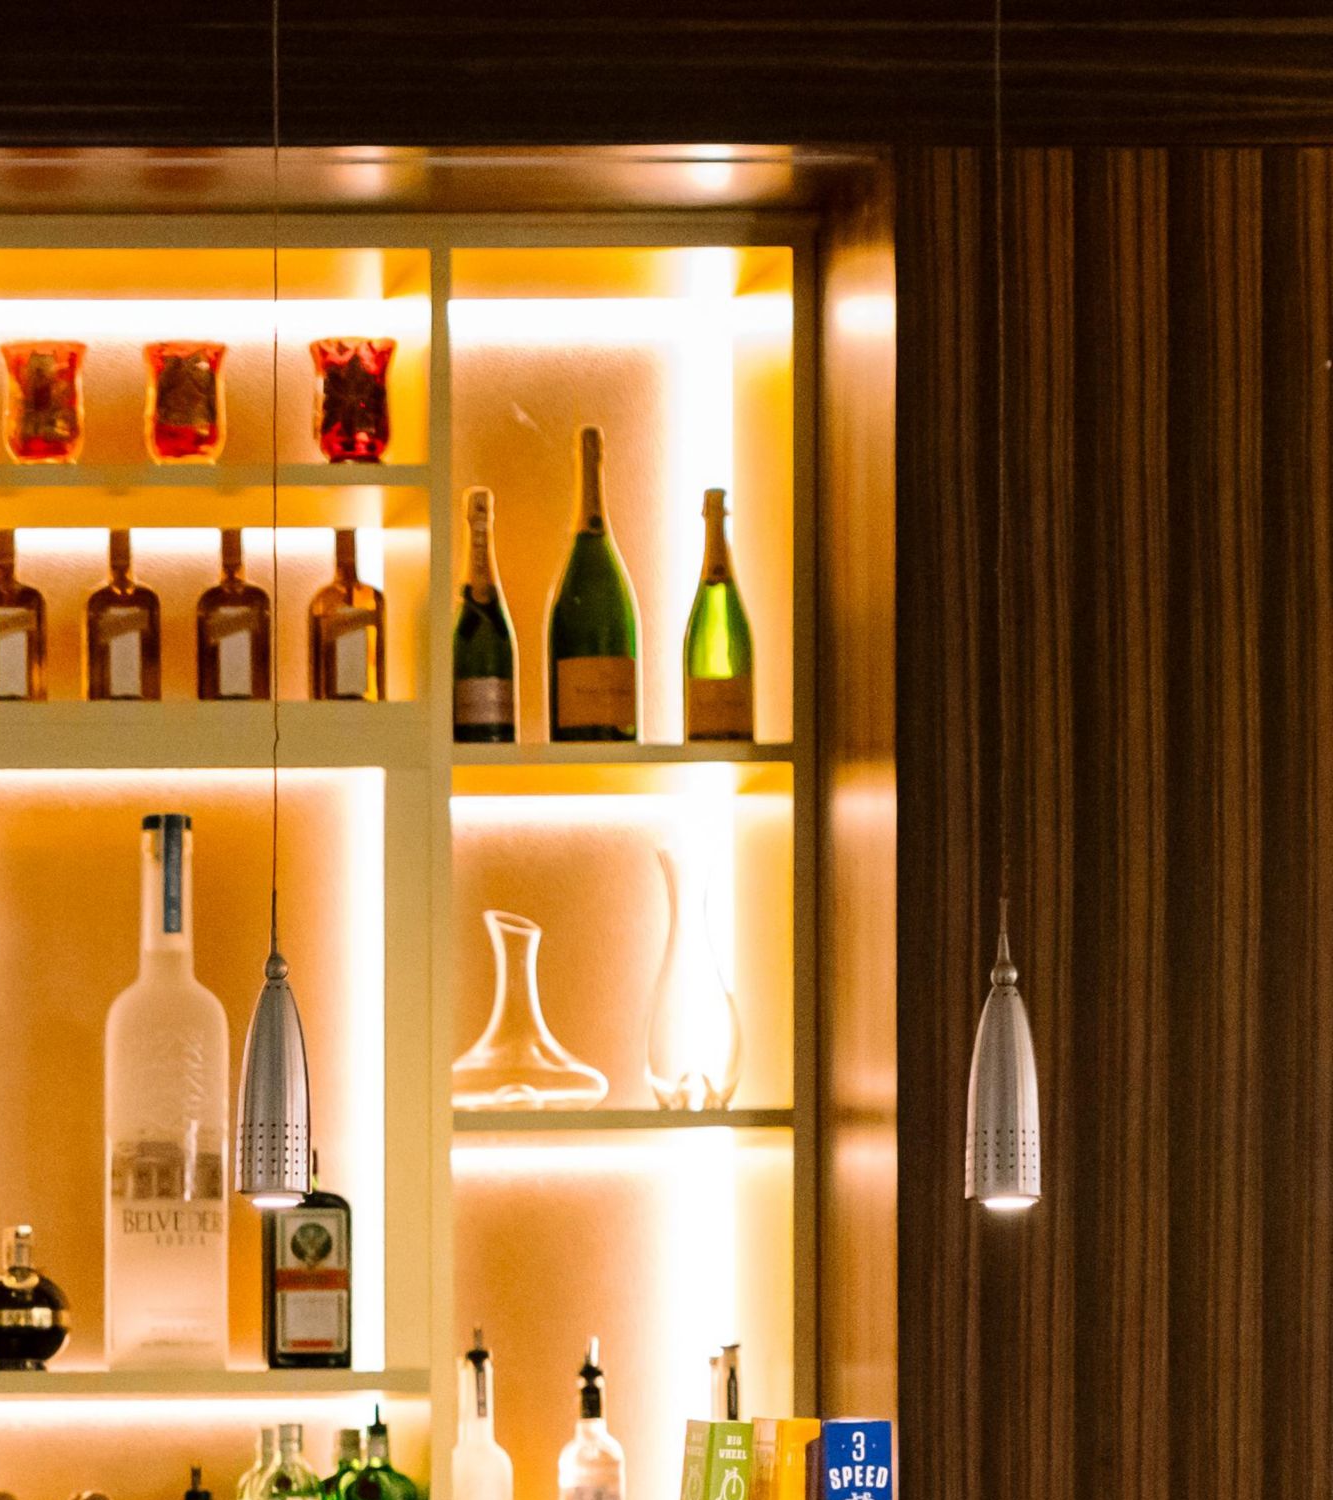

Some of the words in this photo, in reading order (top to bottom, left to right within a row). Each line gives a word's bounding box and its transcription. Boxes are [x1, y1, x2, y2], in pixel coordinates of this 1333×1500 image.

[719, 1448, 748, 1460] WHEEL
[852, 1431, 865, 1462] 3
[829, 1465, 889, 1490] SPEED
